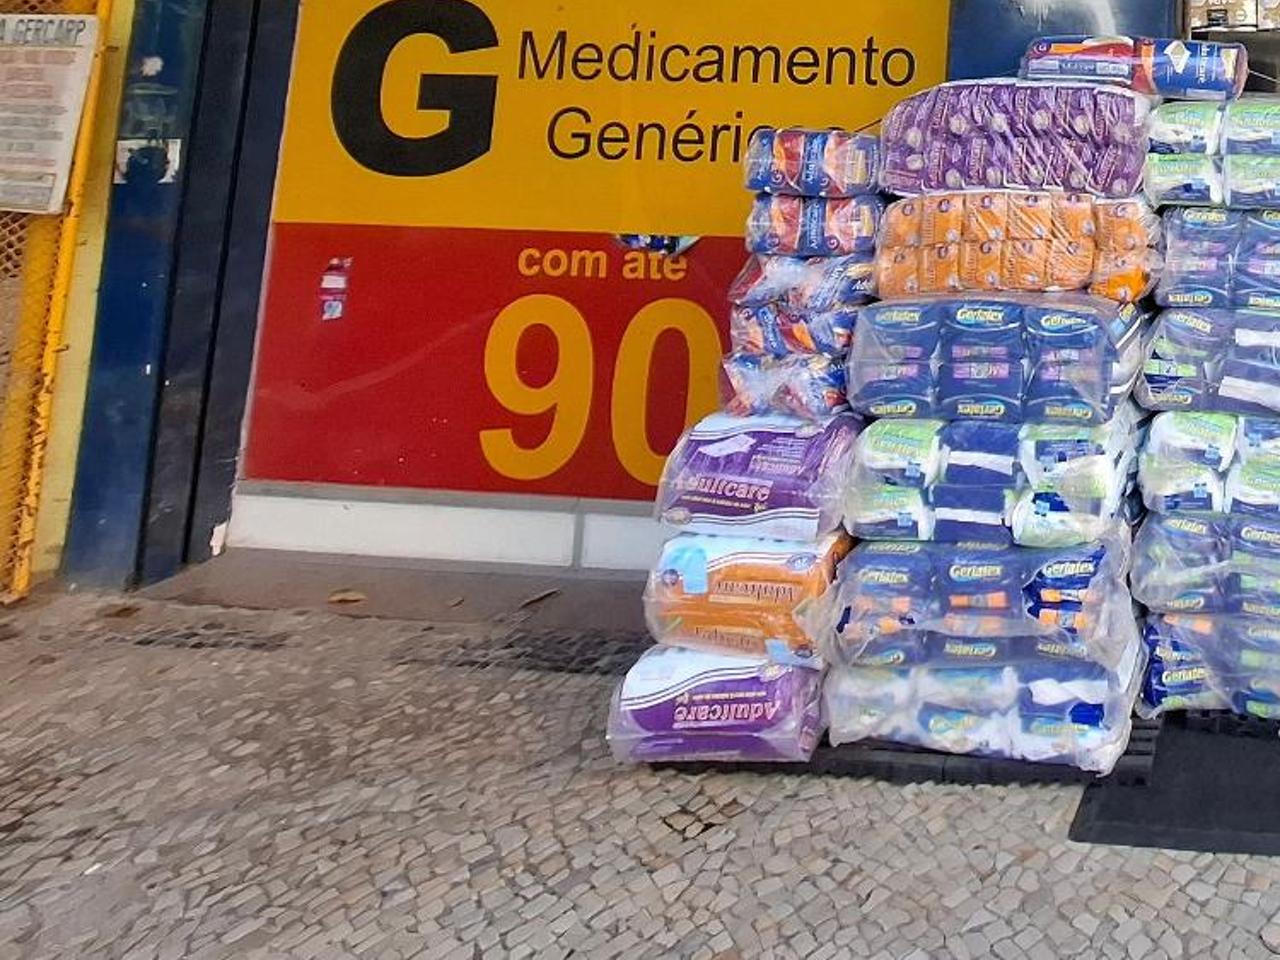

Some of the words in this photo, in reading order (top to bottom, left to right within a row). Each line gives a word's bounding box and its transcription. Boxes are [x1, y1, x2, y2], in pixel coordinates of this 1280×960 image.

[517, 26, 916, 87] Medicamento
[518, 247, 607, 279] com
[479, 293, 723, 487] 90
